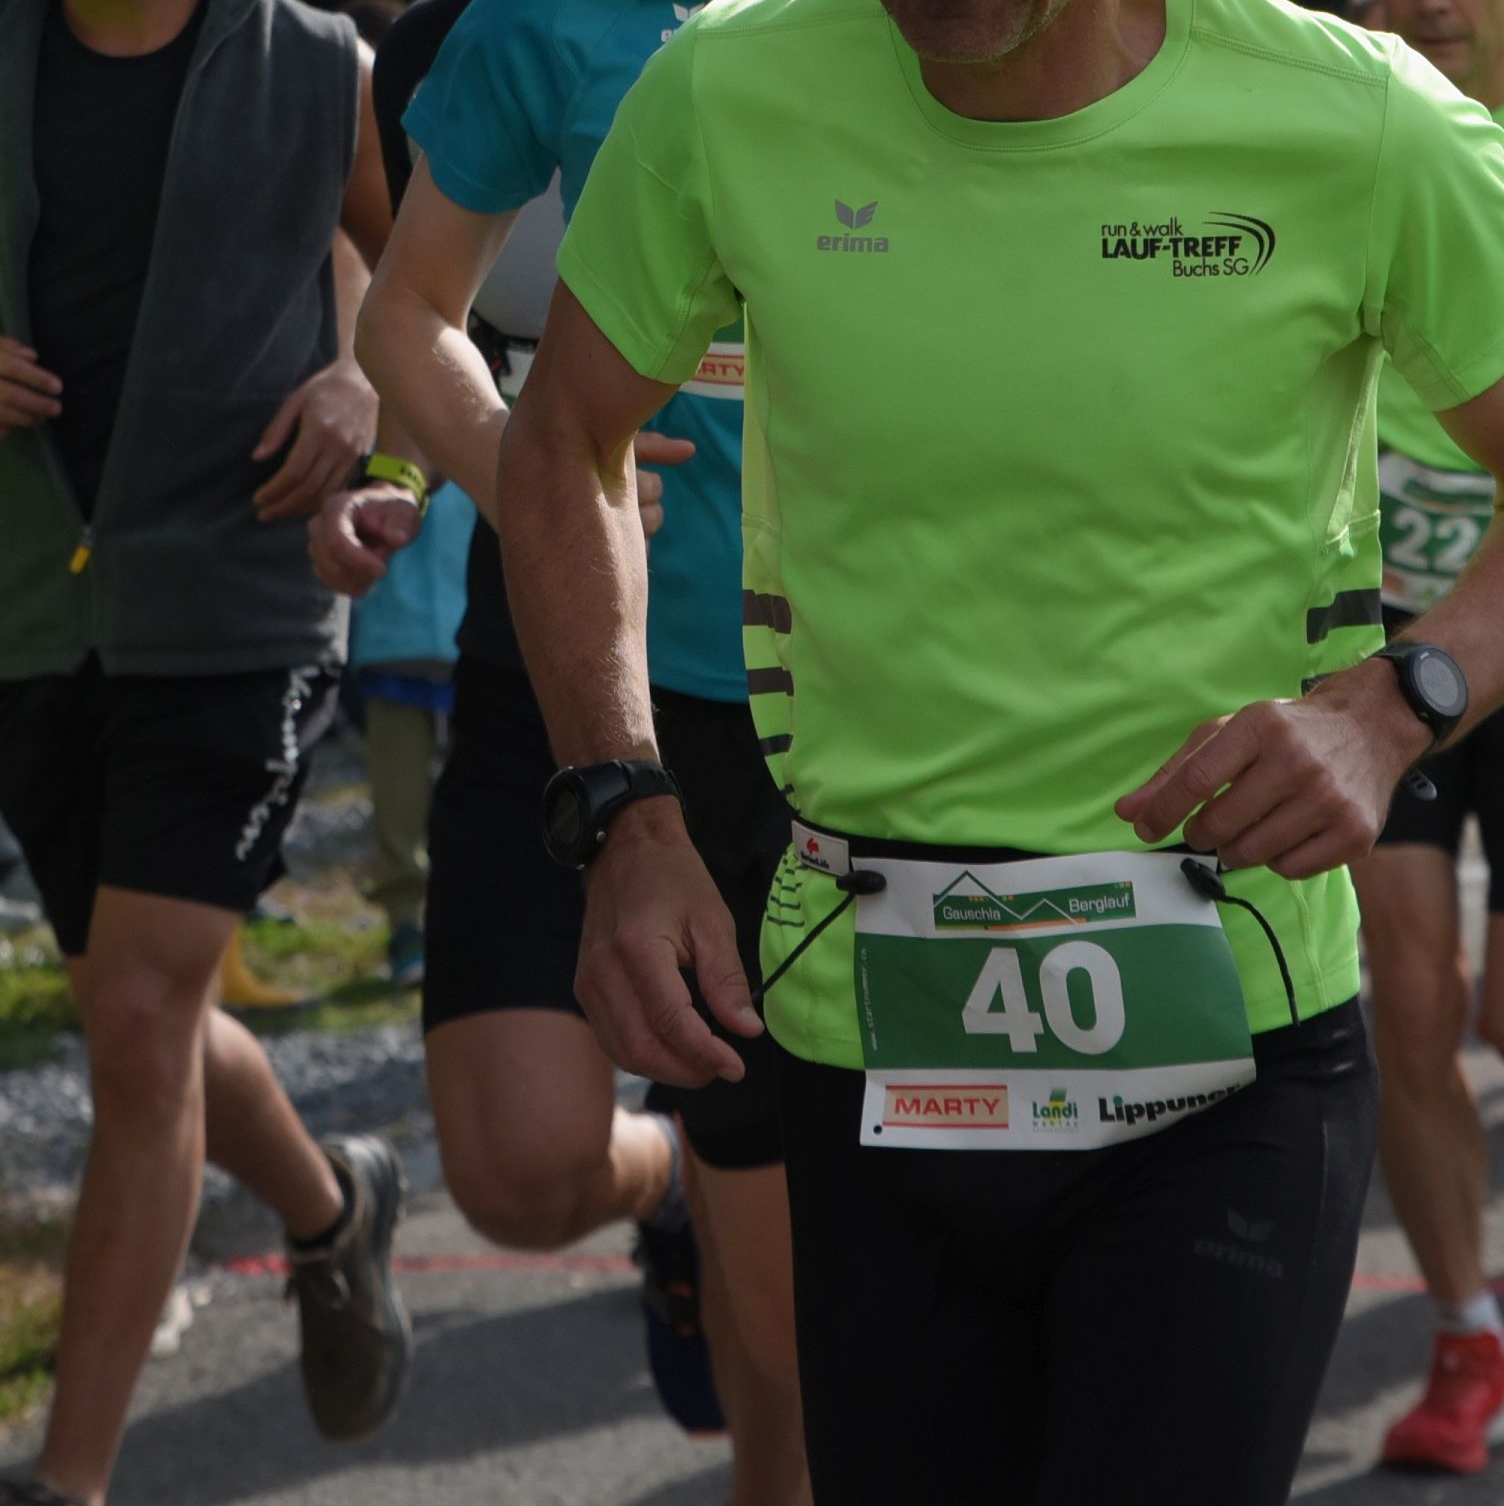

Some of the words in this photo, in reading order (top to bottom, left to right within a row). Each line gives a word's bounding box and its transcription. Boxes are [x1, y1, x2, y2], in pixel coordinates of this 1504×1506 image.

[1101, 222, 1129, 237] run
[1130, 221, 1141, 237] &
[1142, 216, 1184, 237] walk
[816, 233, 889, 254] erima
[1101, 236, 1243, 260] LAUF-TREFF
[1173, 257, 1220, 278] Buchs
[1223, 257, 1250, 276] SG
[702, 362, 744, 377] RTY
[943, 905, 1002, 922] Gauschla
[1069, 892, 1131, 914] Berglauf
[961, 940, 1127, 1055] 40
[894, 1096, 1001, 1117] MARTY
[1032, 1101, 1079, 1119] Landi
